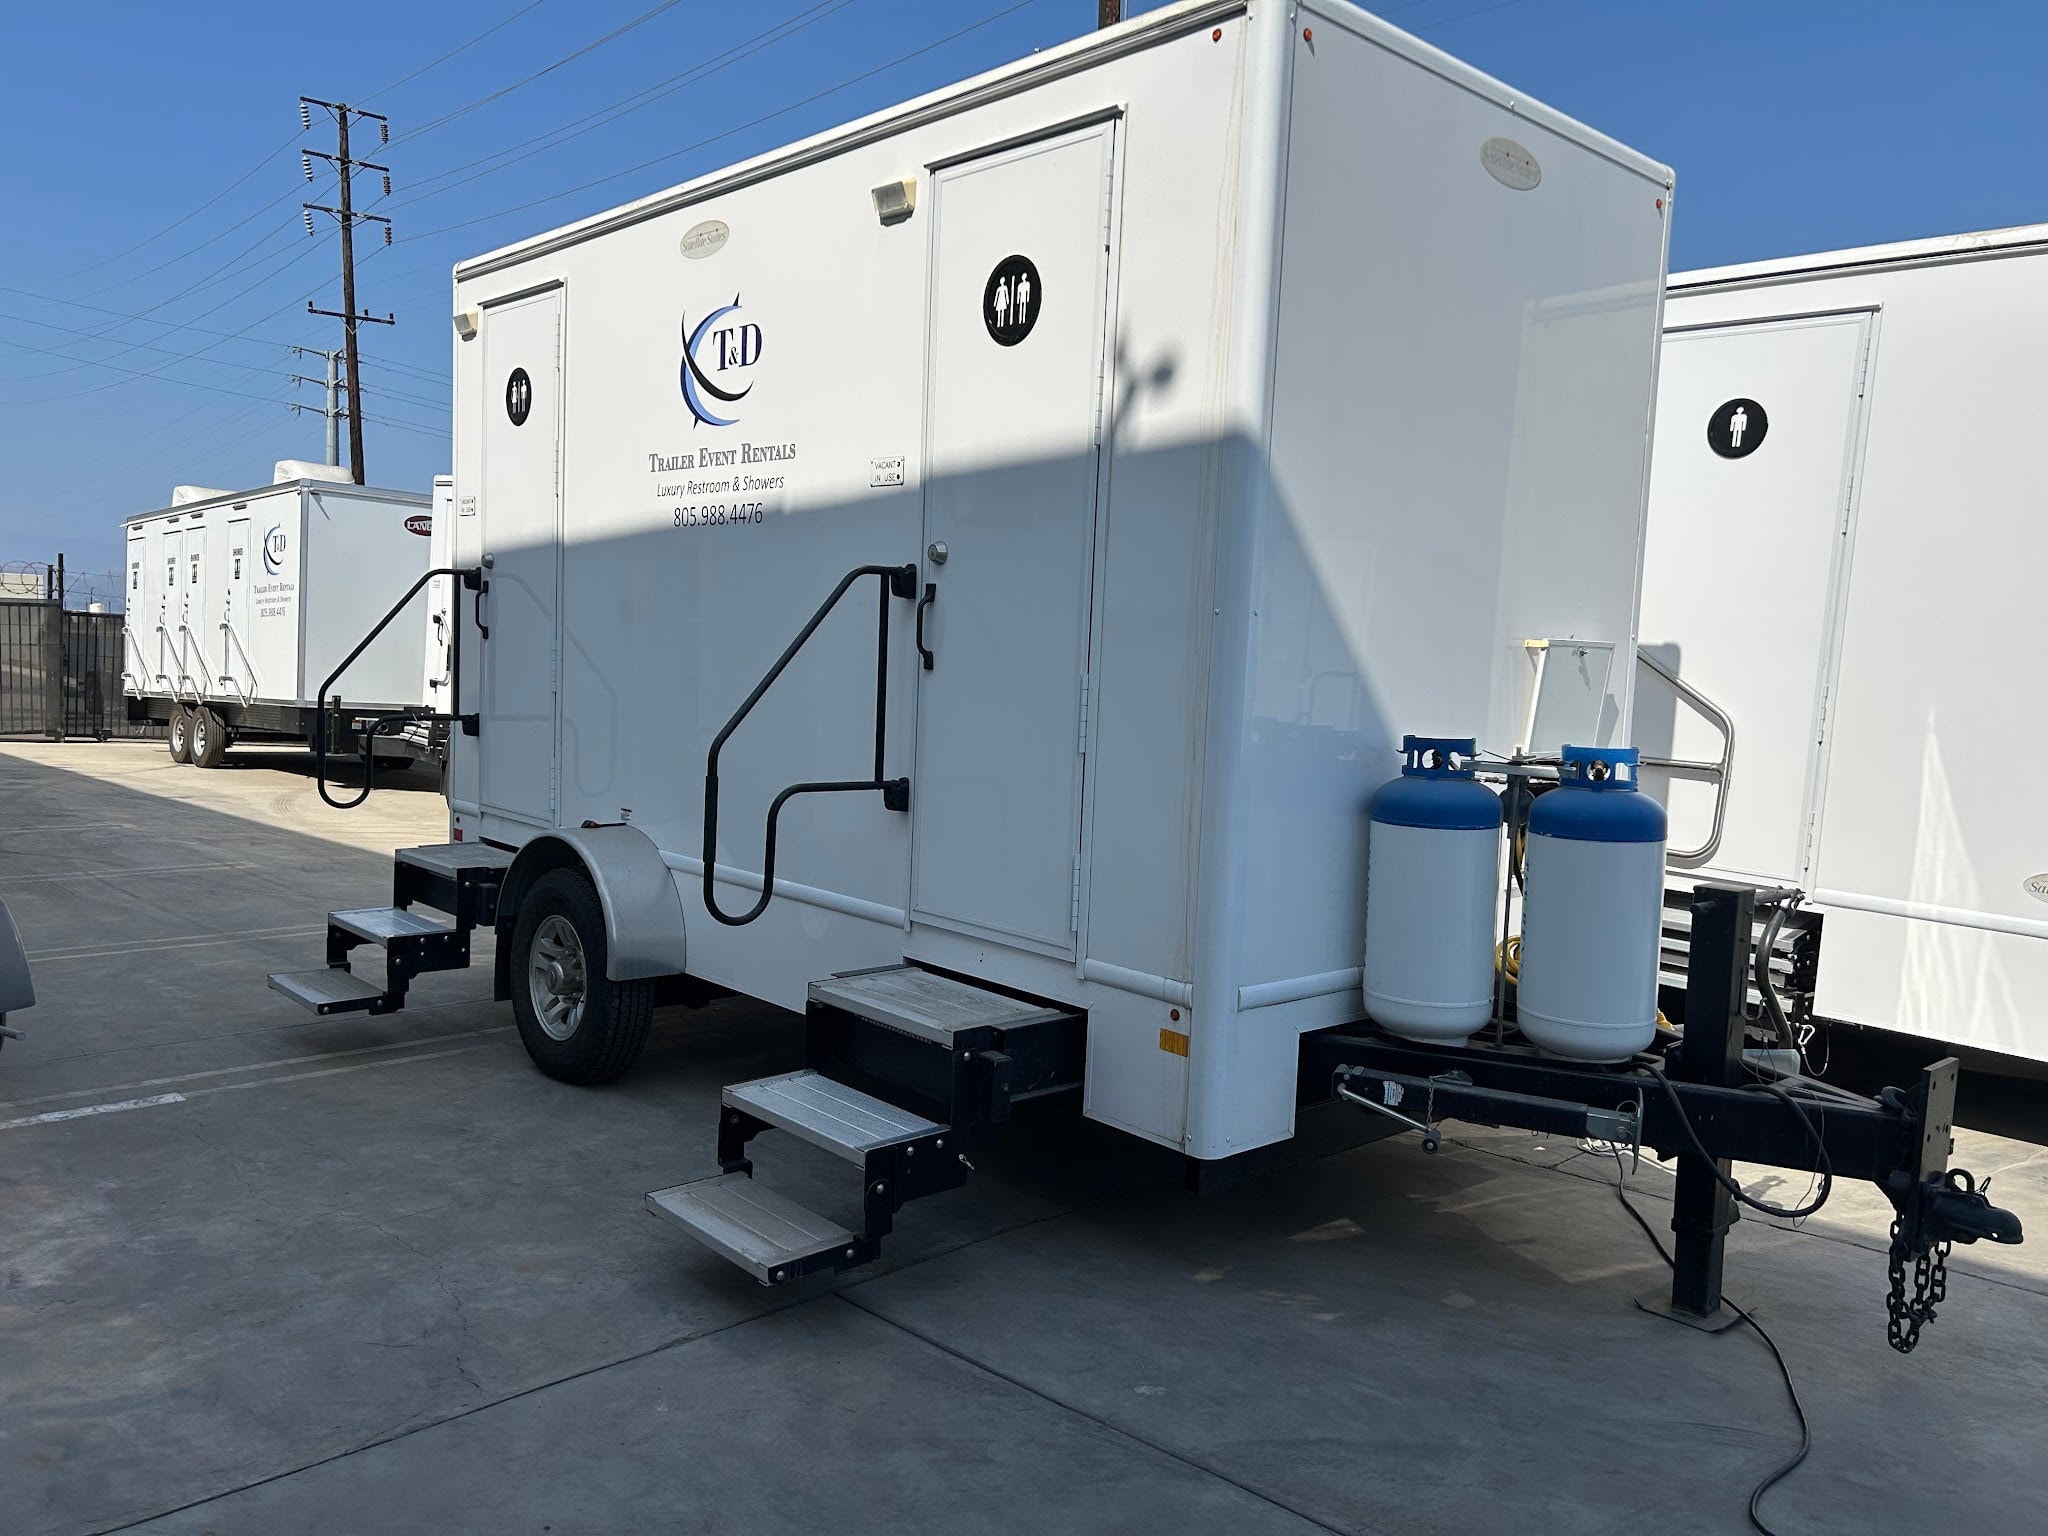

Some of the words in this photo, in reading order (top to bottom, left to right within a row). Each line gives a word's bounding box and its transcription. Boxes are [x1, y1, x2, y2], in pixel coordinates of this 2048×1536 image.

[712, 323, 762, 371] T&D
[648, 452, 695, 472] TRAILER
[698, 447, 737, 468] EVENT
[740, 443, 796, 464] RENTALS
[875, 460, 895, 470] VACANT
[657, 483, 685, 499] Luxury
[687, 480, 730, 495] Restroom
[732, 476, 740, 491] &
[743, 475, 785, 491] Showers
[884, 472, 896, 482] USE
[673, 502, 763, 528] 805.988.4476
[2028, 881, 2048, 895] Sa
